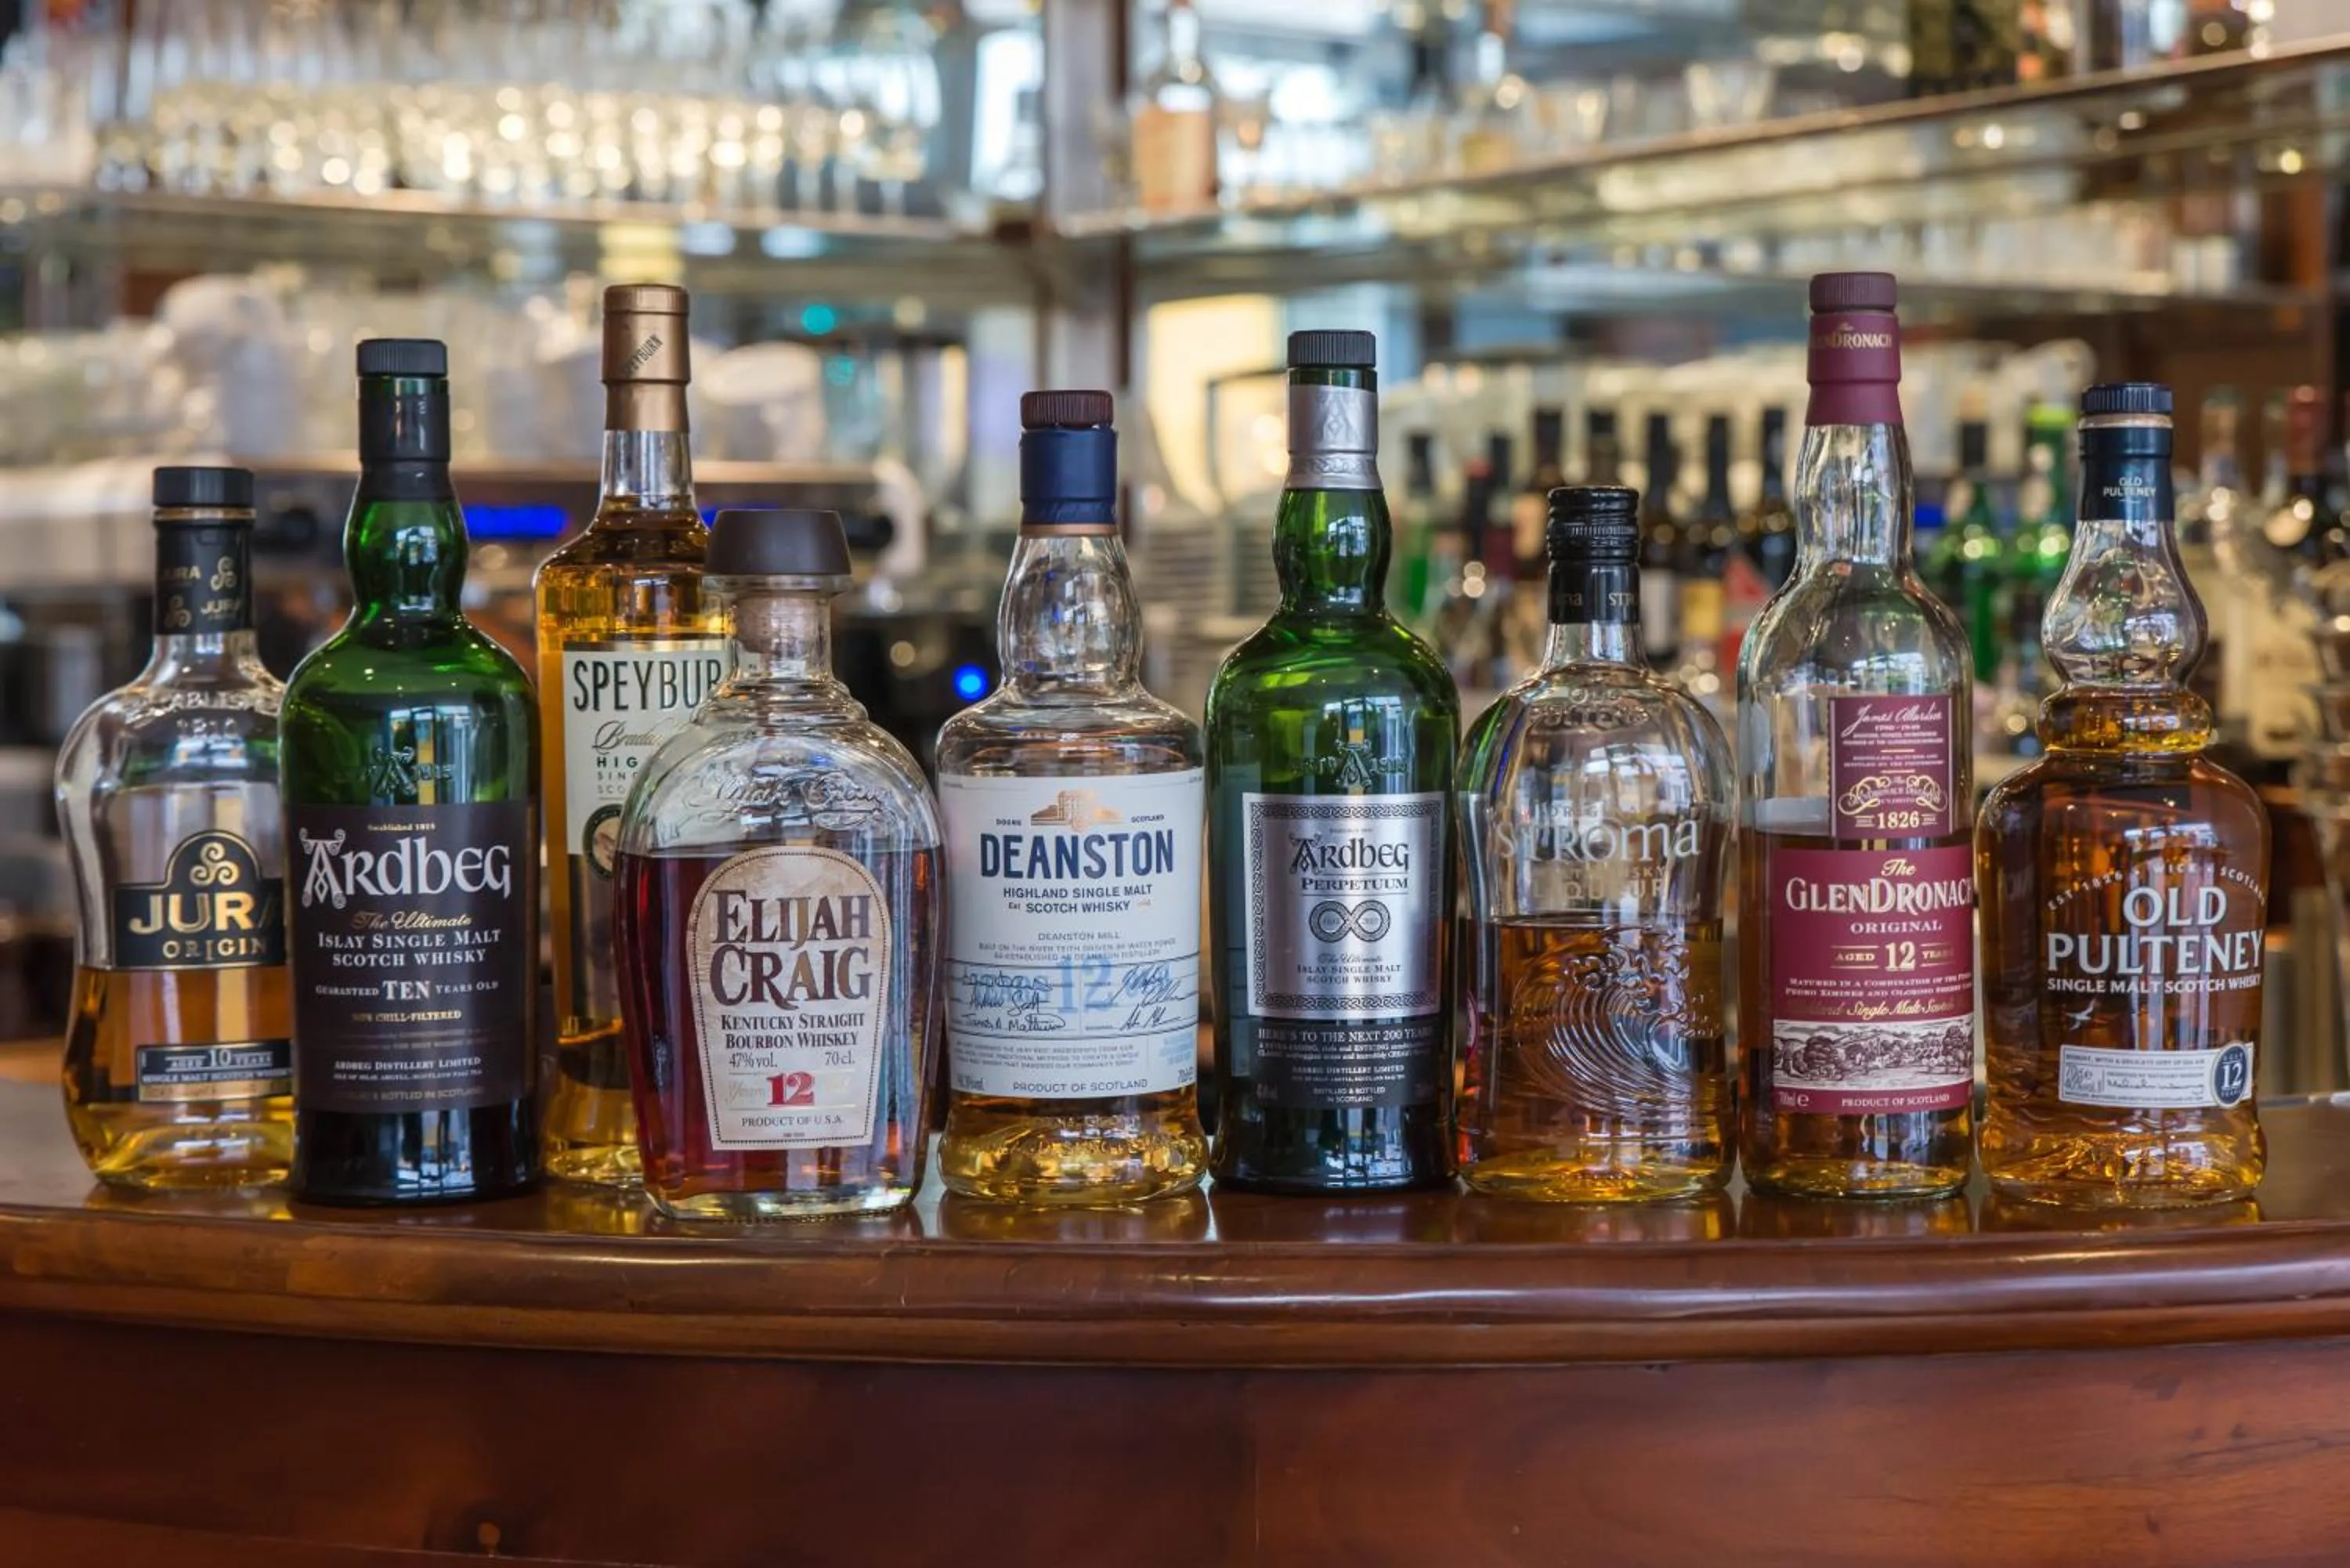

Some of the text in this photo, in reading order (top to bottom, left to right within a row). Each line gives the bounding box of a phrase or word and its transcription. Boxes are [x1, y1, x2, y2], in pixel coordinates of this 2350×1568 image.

[2119, 476, 2142, 486] OLD
[2102, 486, 2157, 497] PULTENEY
[573, 658, 721, 712] SPEYBUR
[596, 756, 638, 768] HIG
[598, 771, 637, 781] SIN
[598, 785, 626, 794] SCO
[1877, 811, 1920, 829] 1826
[980, 829, 1173, 880] DEANSTON
[1288, 832, 1410, 876] Ardbeg
[299, 827, 511, 909] Ardbeg
[1881, 858, 1917, 877] The
[2081, 871, 2124, 891] 1826
[2153, 862, 2197, 875] WICK
[1003, 884, 1153, 899] HIGHLAND SINGLE MALT
[1301, 877, 1408, 891] PERPETUUM
[1025, 902, 1077, 914] SCOTCH
[1082, 901, 1130, 913] WHISKY
[2122, 886, 2228, 927] OLD
[352, 909, 472, 930] The Ultimate
[711, 890, 871, 951] ELIJAH
[1849, 919, 1943, 934] ORIGINAL
[318, 929, 501, 949] ISLAY SINGLE MALT
[1038, 930, 1121, 941] DEANSTON MILL
[162, 937, 267, 962] ORIGIN
[333, 949, 486, 967] SCOTCH WHISKY
[1835, 952, 1875, 962] AGED
[1885, 941, 1916, 972] 12
[2046, 929, 2264, 975] PULTENEY
[710, 944, 873, 1010] CRAIG
[1297, 963, 1401, 974] ISLAY SINGLE MALT
[1057, 957, 1113, 1013] 12
[1307, 974, 1392, 984] SCOTCH WHISKY
[1789, 977, 1837, 988] MATURED
[2047, 973, 2261, 995] SINGLE MALT SCOTCH WHISKY
[316, 980, 499, 1000] GUARANTEED TEN YEARS OLD
[375, 1010, 461, 1023] CHILL-FILTERED
[1846, 999, 1889, 1021] Single
[1889, 999, 1922, 1016] Malt
[721, 1013, 865, 1030] KENTUCKY STRAIGHT
[725, 1031, 859, 1049] BOURBON WHISKEY
[1301, 1031, 1318, 1042] TO
[1320, 1031, 1346, 1042] THE
[1348, 1031, 1381, 1042] NEXT
[1383, 1028, 1403, 1041] 200
[208, 1048, 232, 1068] 10
[375, 1060, 435, 1071] DISTILLERY
[439, 1057, 481, 1068] LIMITED
[1374, 1064, 1405, 1073] LIMITED
[2222, 1062, 2243, 1089] 12
[766, 1071, 815, 1107] 12
[1013, 1078, 1148, 1093] PRODUCT OF SCOTLAND
[1842, 1093, 1950, 1107] PRODUCT OF SCOTLAND
[742, 1116, 794, 1127] PRODUCT
[797, 1115, 810, 1125] OF
